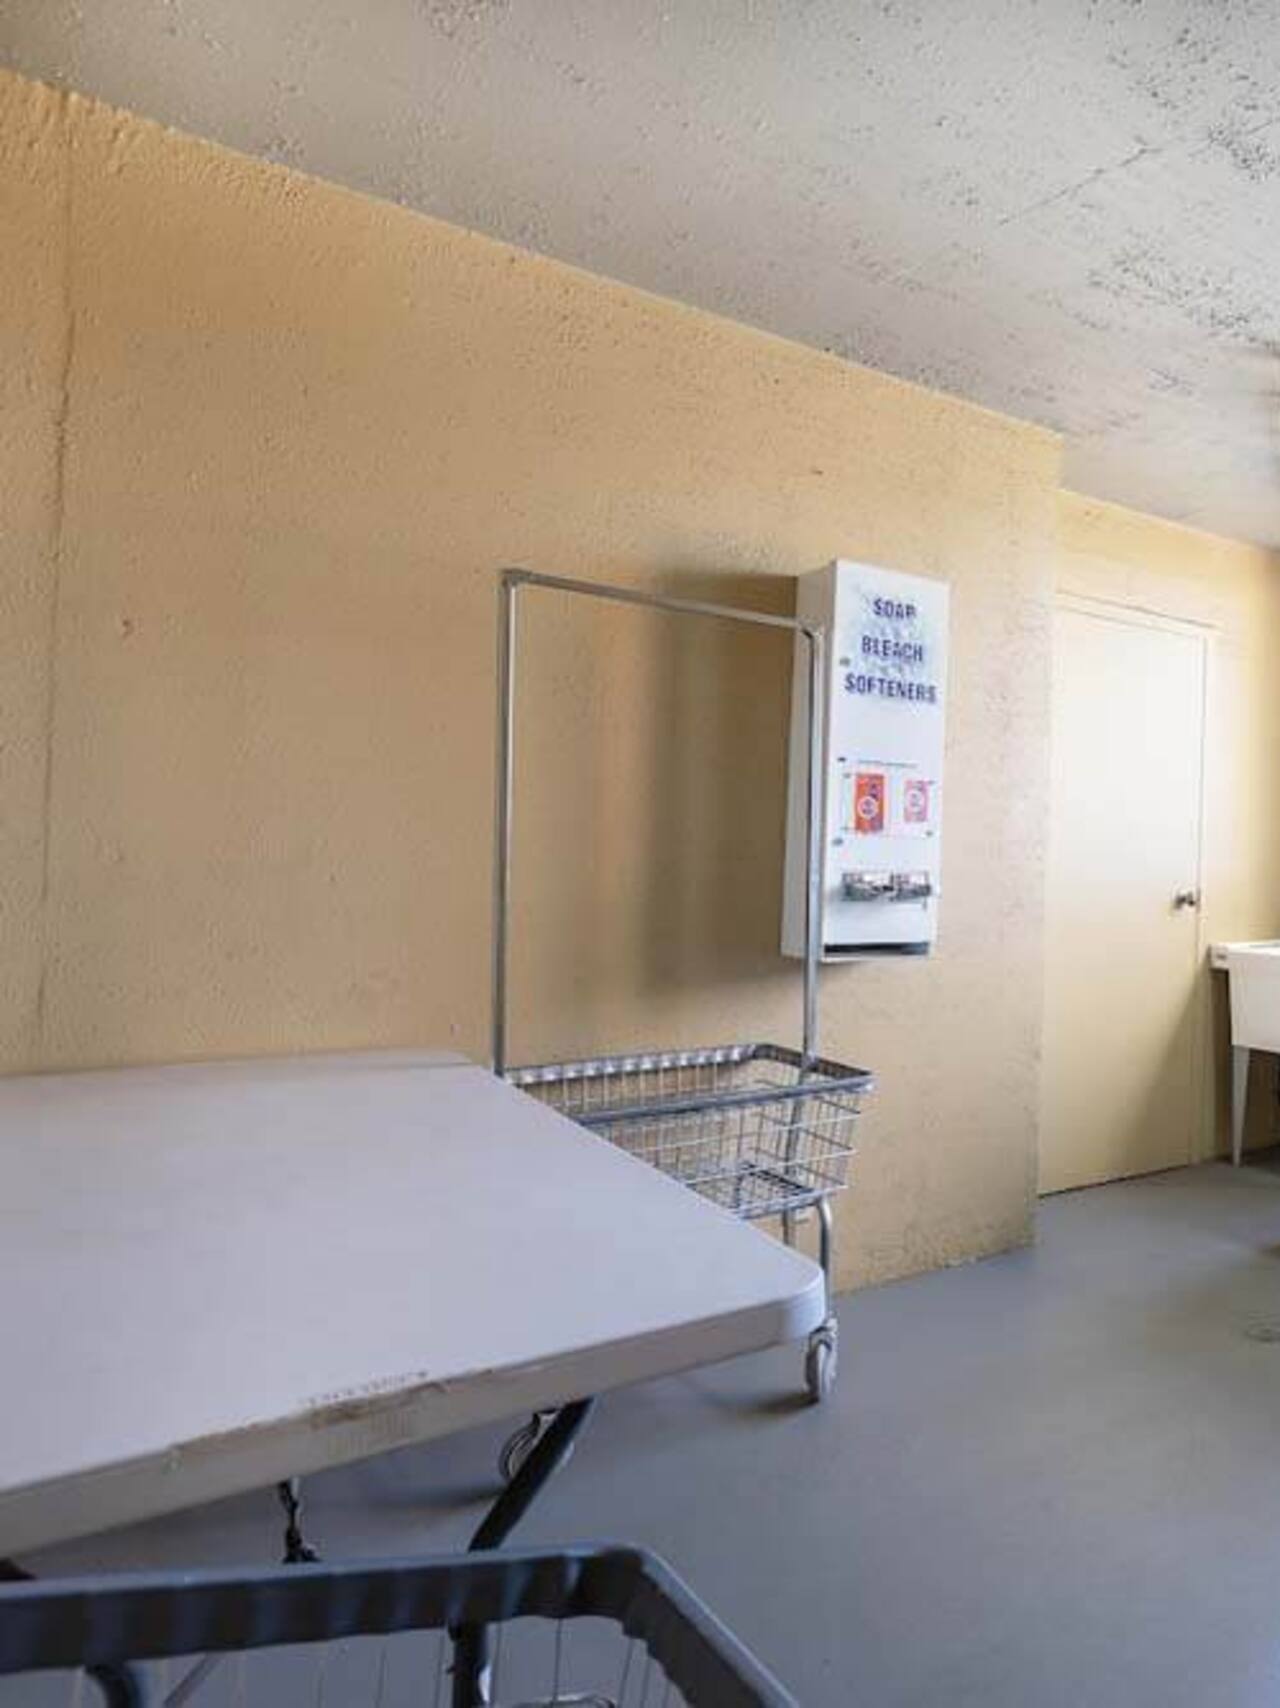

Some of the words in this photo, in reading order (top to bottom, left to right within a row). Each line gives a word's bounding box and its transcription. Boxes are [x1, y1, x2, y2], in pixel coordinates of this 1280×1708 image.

[873, 598, 916, 619] SOAP
[861, 634, 923, 662] BLEACH
[844, 672, 937, 703] SOFTENERS
